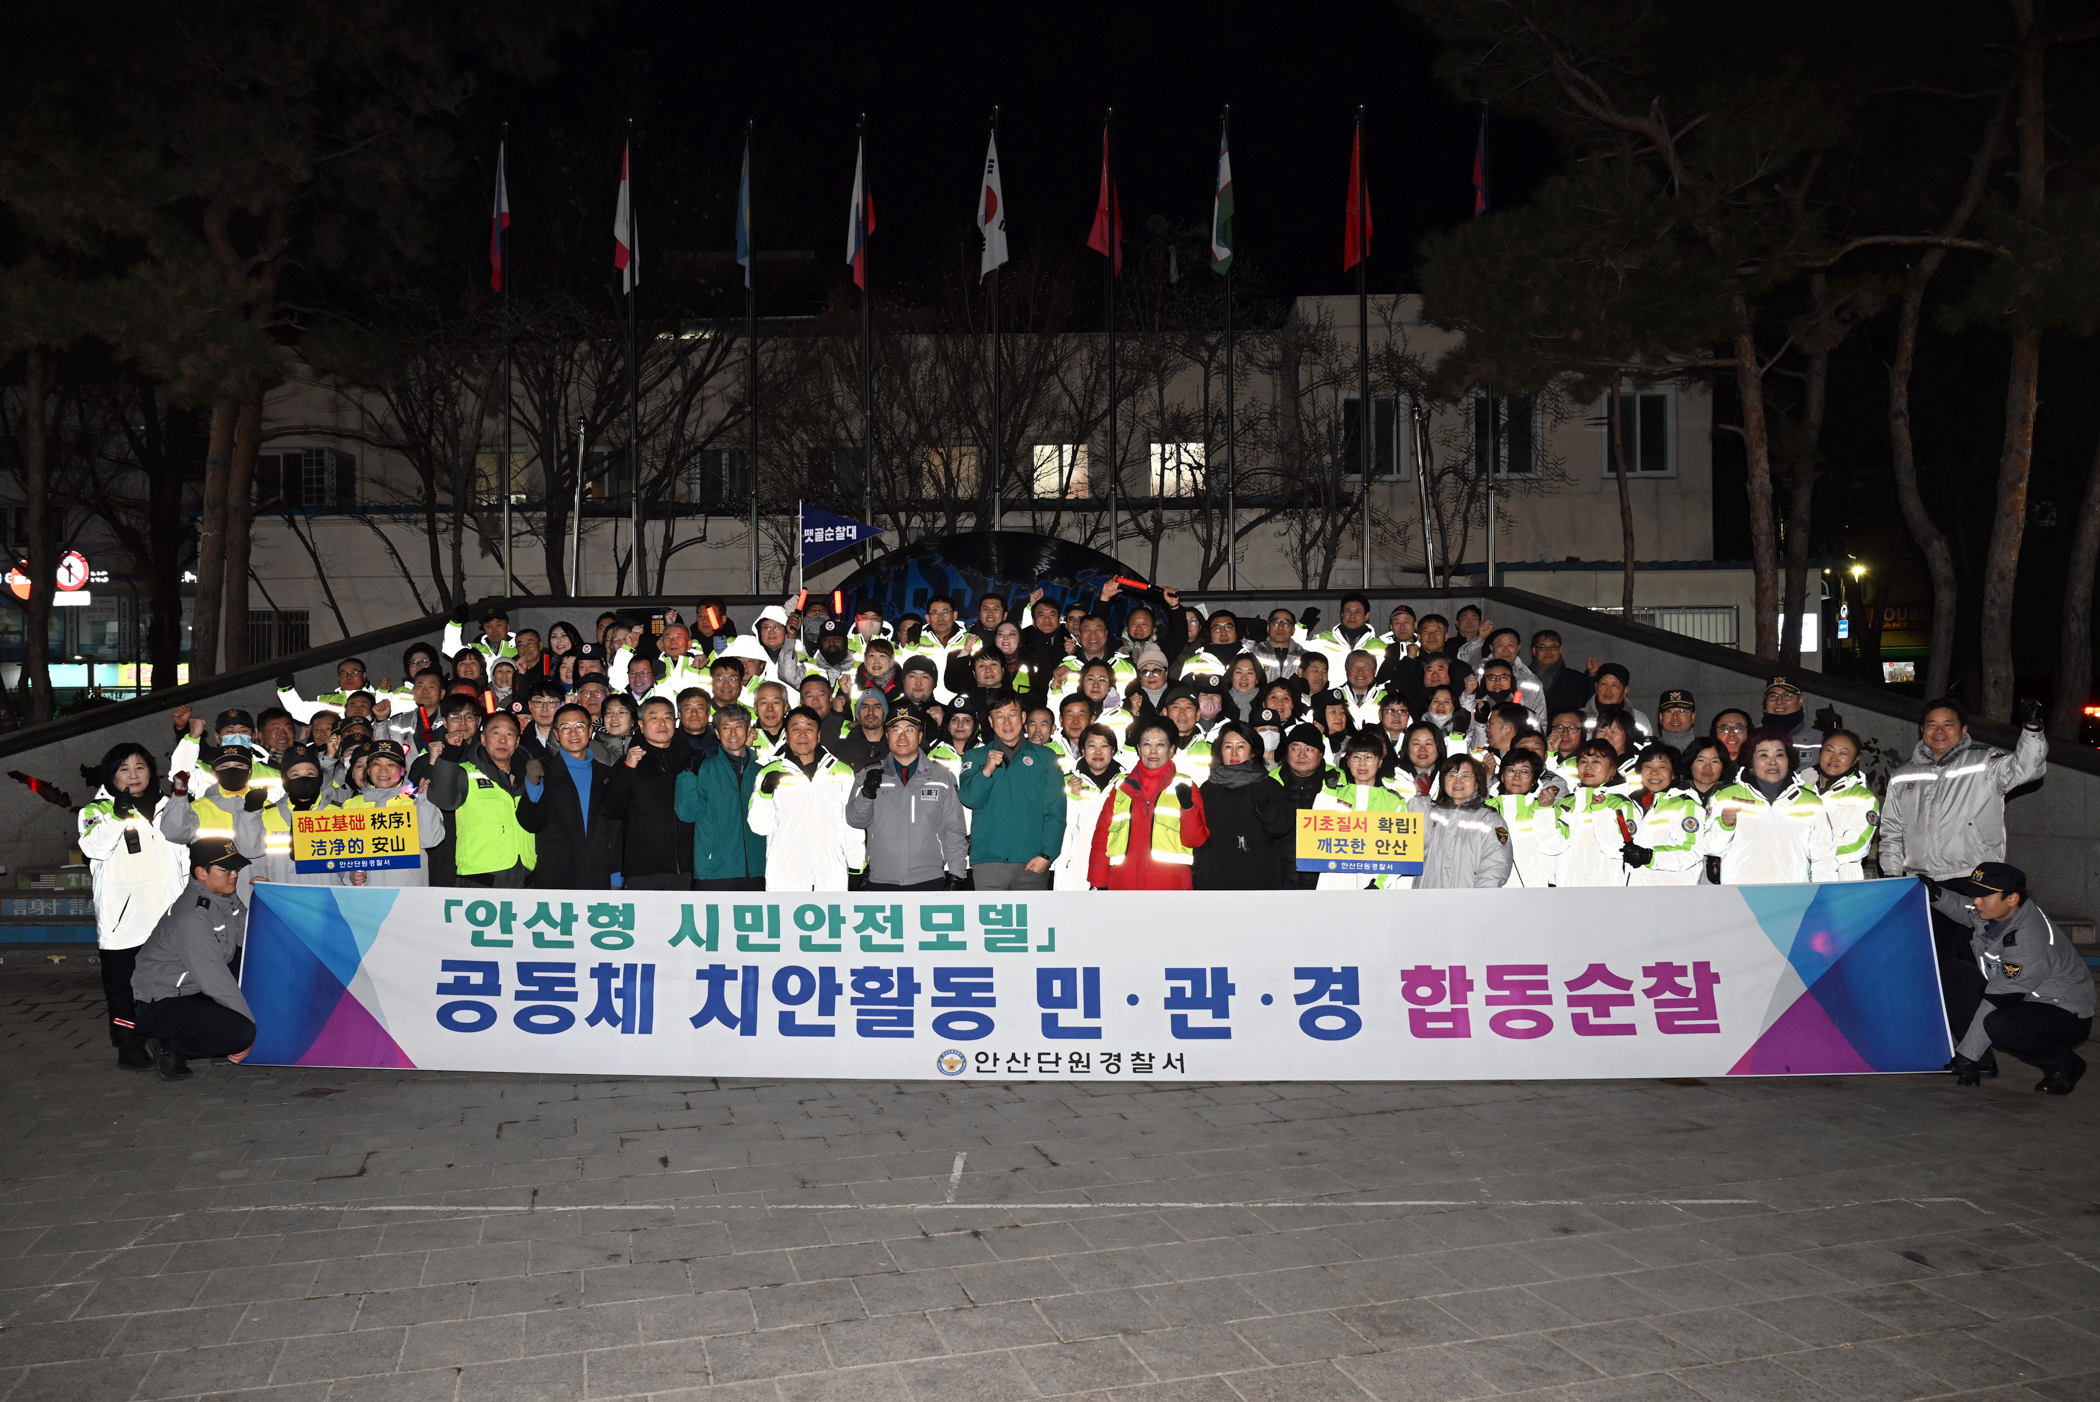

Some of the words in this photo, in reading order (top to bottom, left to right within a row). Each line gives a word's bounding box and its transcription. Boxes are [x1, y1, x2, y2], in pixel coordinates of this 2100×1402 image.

[298, 814, 366, 833] 确立基础
[370, 811, 412, 830] 秩序!
[1303, 815, 1368, 833] 기초질서
[1377, 817, 1417, 834] 확립!
[311, 837, 364, 857] 洁净的
[372, 835, 406, 854] 安山
[1317, 837, 1366, 855] 깨끗한
[1375, 839, 1408, 856] 안산
[339, 859, 391, 869] 안산단원경찰서
[1341, 861, 1394, 871] 안산단원경찰서
[445, 899, 636, 951] 「안산형
[669, 903, 1056, 953] 시민안전모델」
[437, 959, 656, 1035] 공동체
[690, 964, 996, 1041] 치안활동
[1402, 961, 1721, 1040] 합동순찰
[975, 1051, 1185, 1075] 안산단원경찰서
